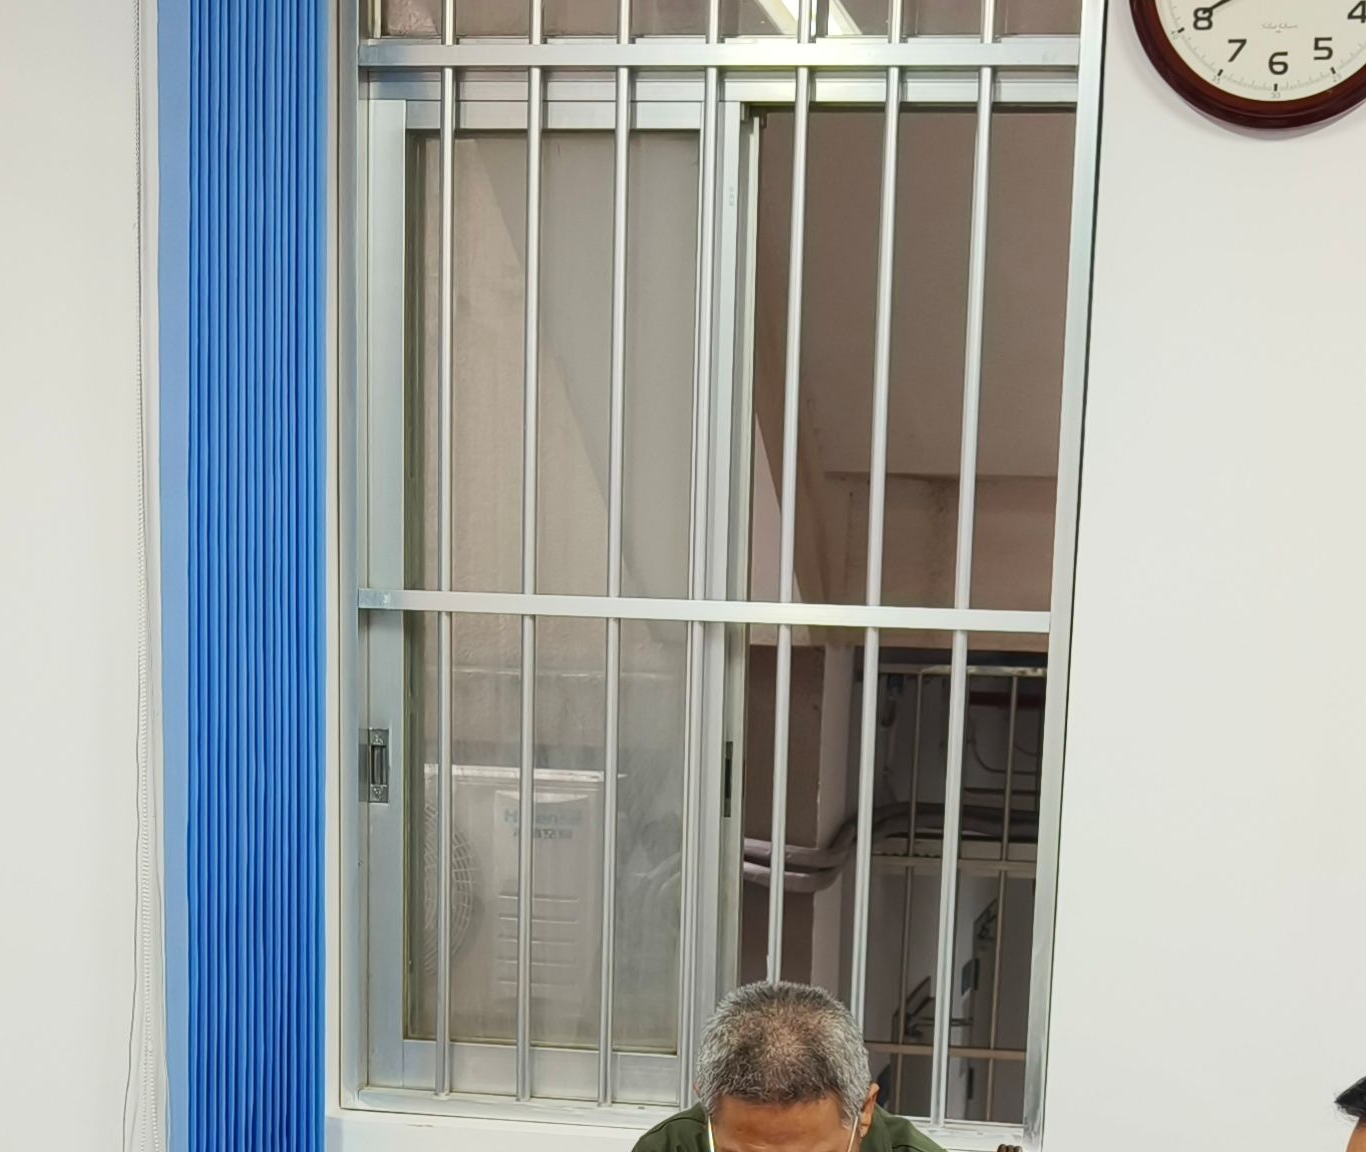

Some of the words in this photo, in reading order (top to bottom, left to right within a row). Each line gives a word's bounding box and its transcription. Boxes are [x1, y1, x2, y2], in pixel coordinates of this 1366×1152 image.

[1193, 7, 1214, 30] 8
[1227, 38, 1247, 63] 7
[1313, 37, 1334, 61] 5
[1268, 51, 1289, 75] 6
